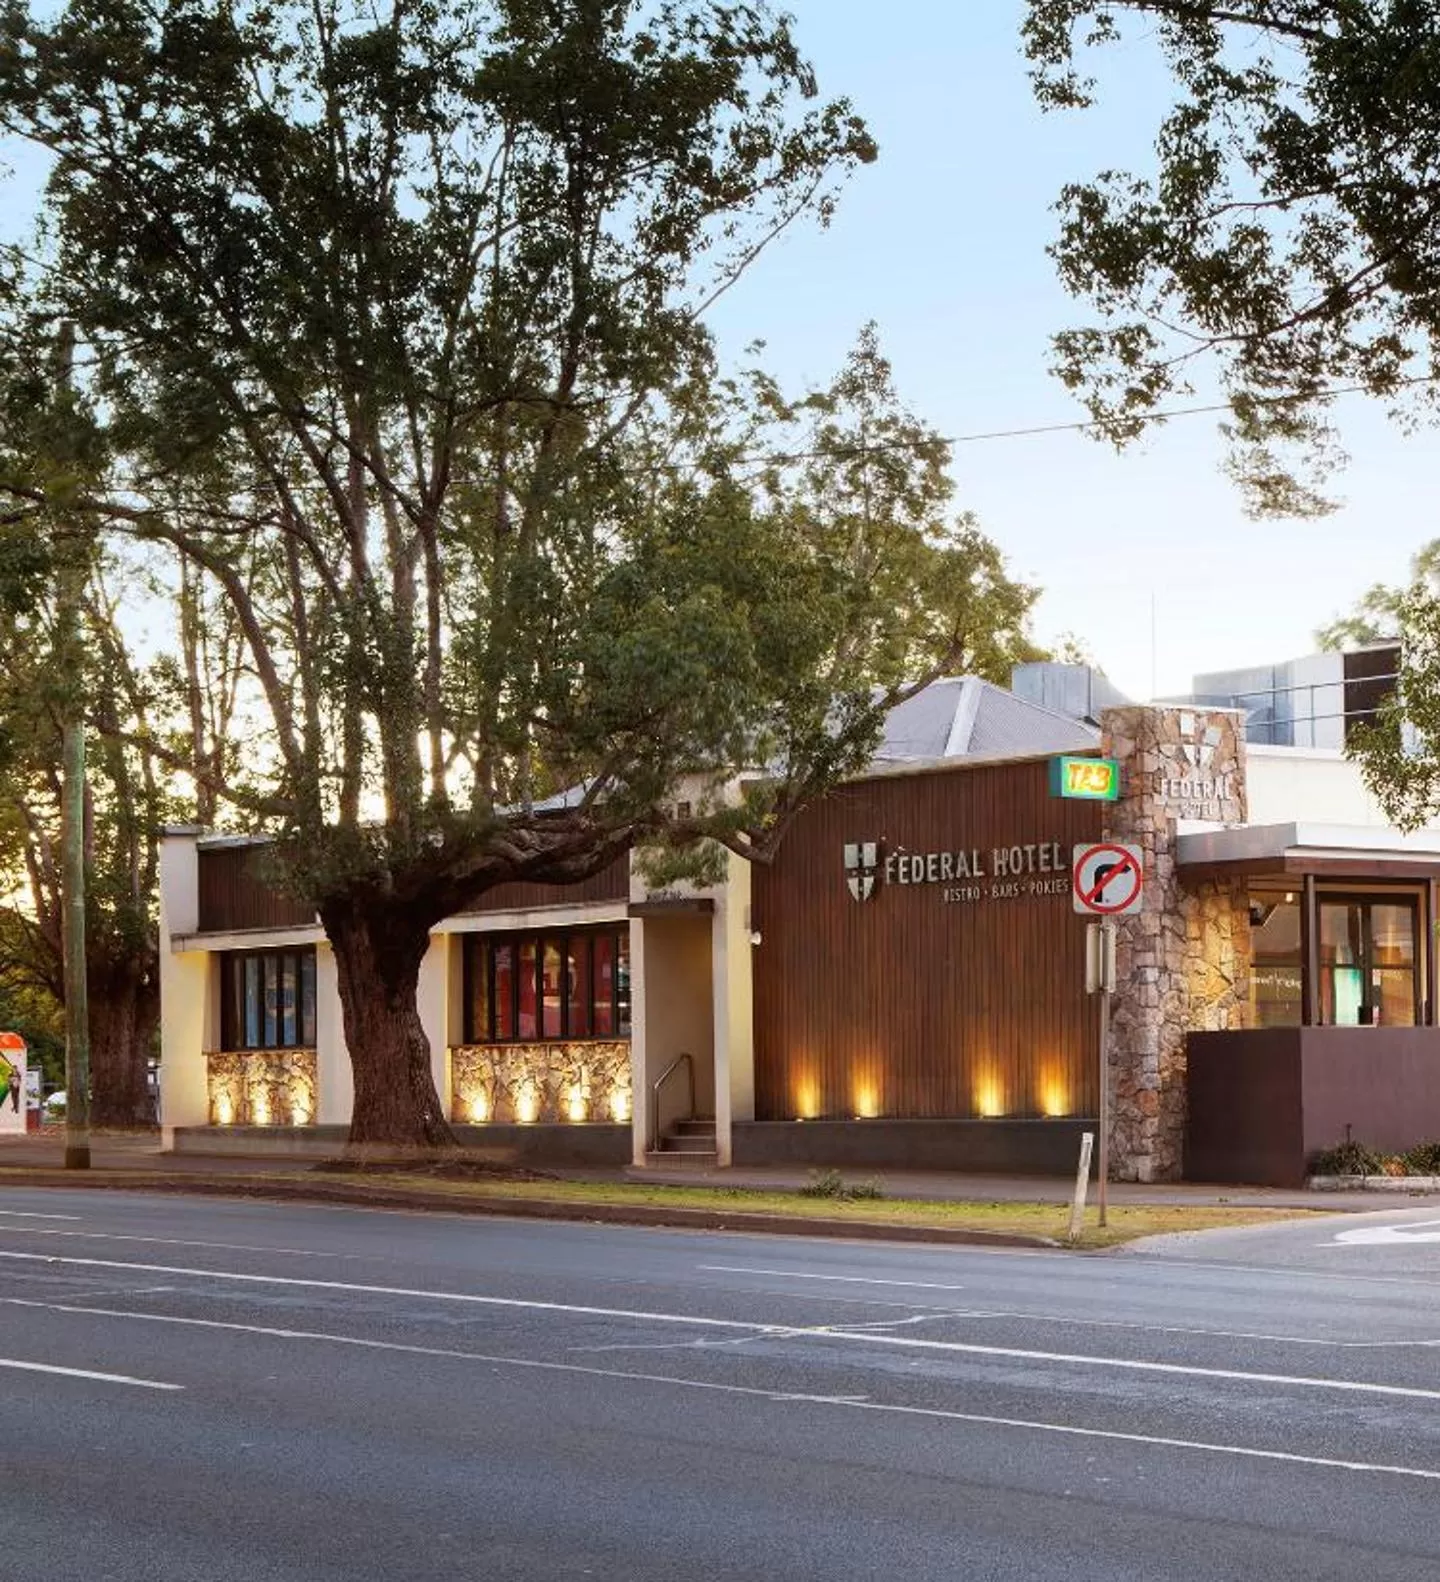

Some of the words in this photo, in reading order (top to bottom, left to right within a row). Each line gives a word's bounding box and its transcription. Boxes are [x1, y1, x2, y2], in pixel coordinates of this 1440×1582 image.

[1067, 763, 1111, 791] TAB
[1161, 773, 1233, 800] FEDERAL
[1182, 801, 1214, 817] HOTEL
[885, 848, 985, 885] FEDERAL
[993, 842, 1067, 877] HOTEL
[944, 886, 980, 902] BISTRO
[992, 883, 1019, 898] BARS
[1030, 879, 1069, 895] POKIES
